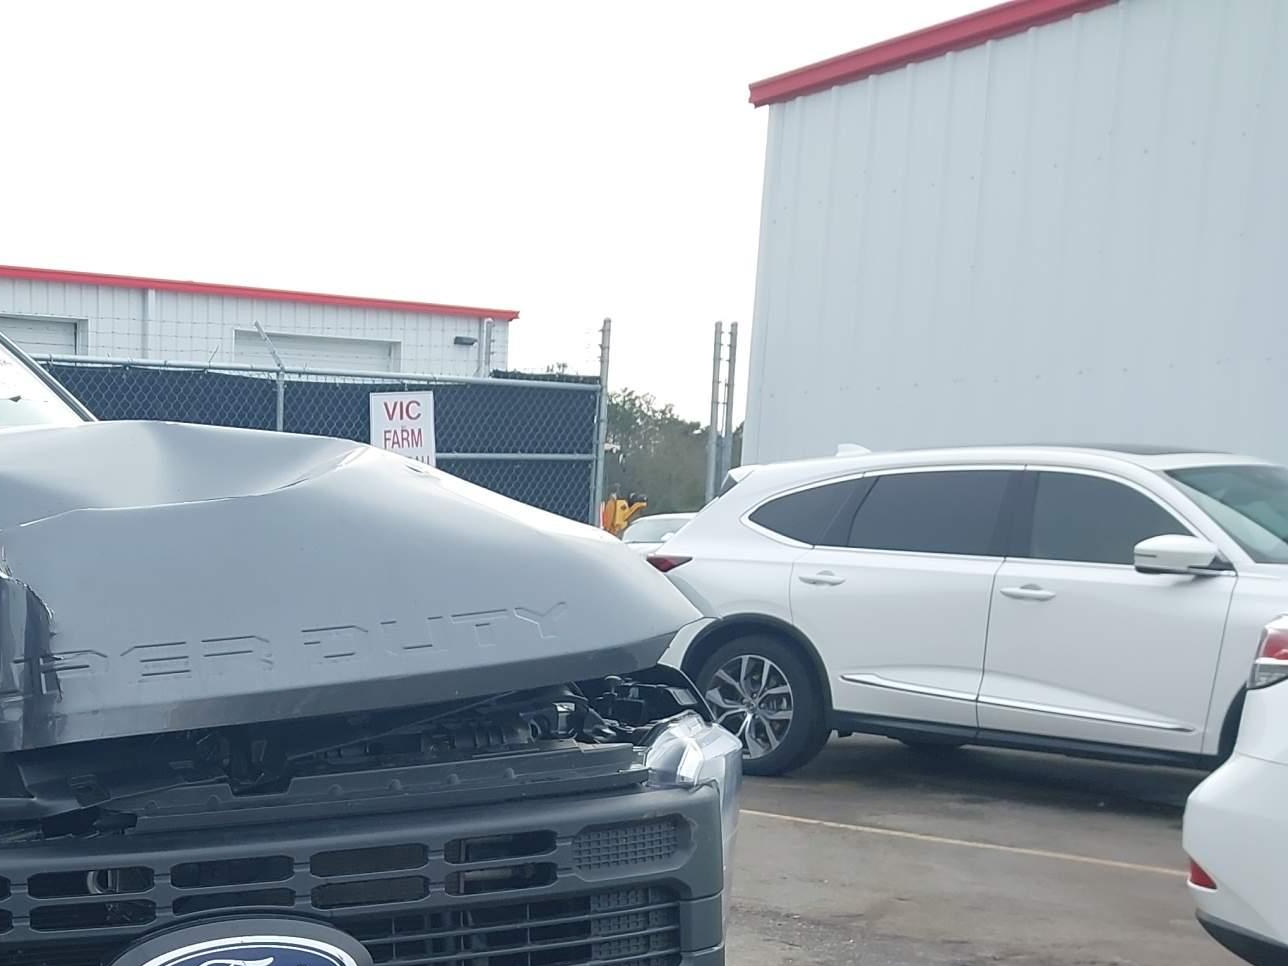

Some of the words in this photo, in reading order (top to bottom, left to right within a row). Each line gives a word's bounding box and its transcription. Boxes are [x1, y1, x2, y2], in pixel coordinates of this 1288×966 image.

[383, 400, 422, 421] VIC
[383, 427, 423, 449] FARM
[300, 601, 568, 664] DUTY
